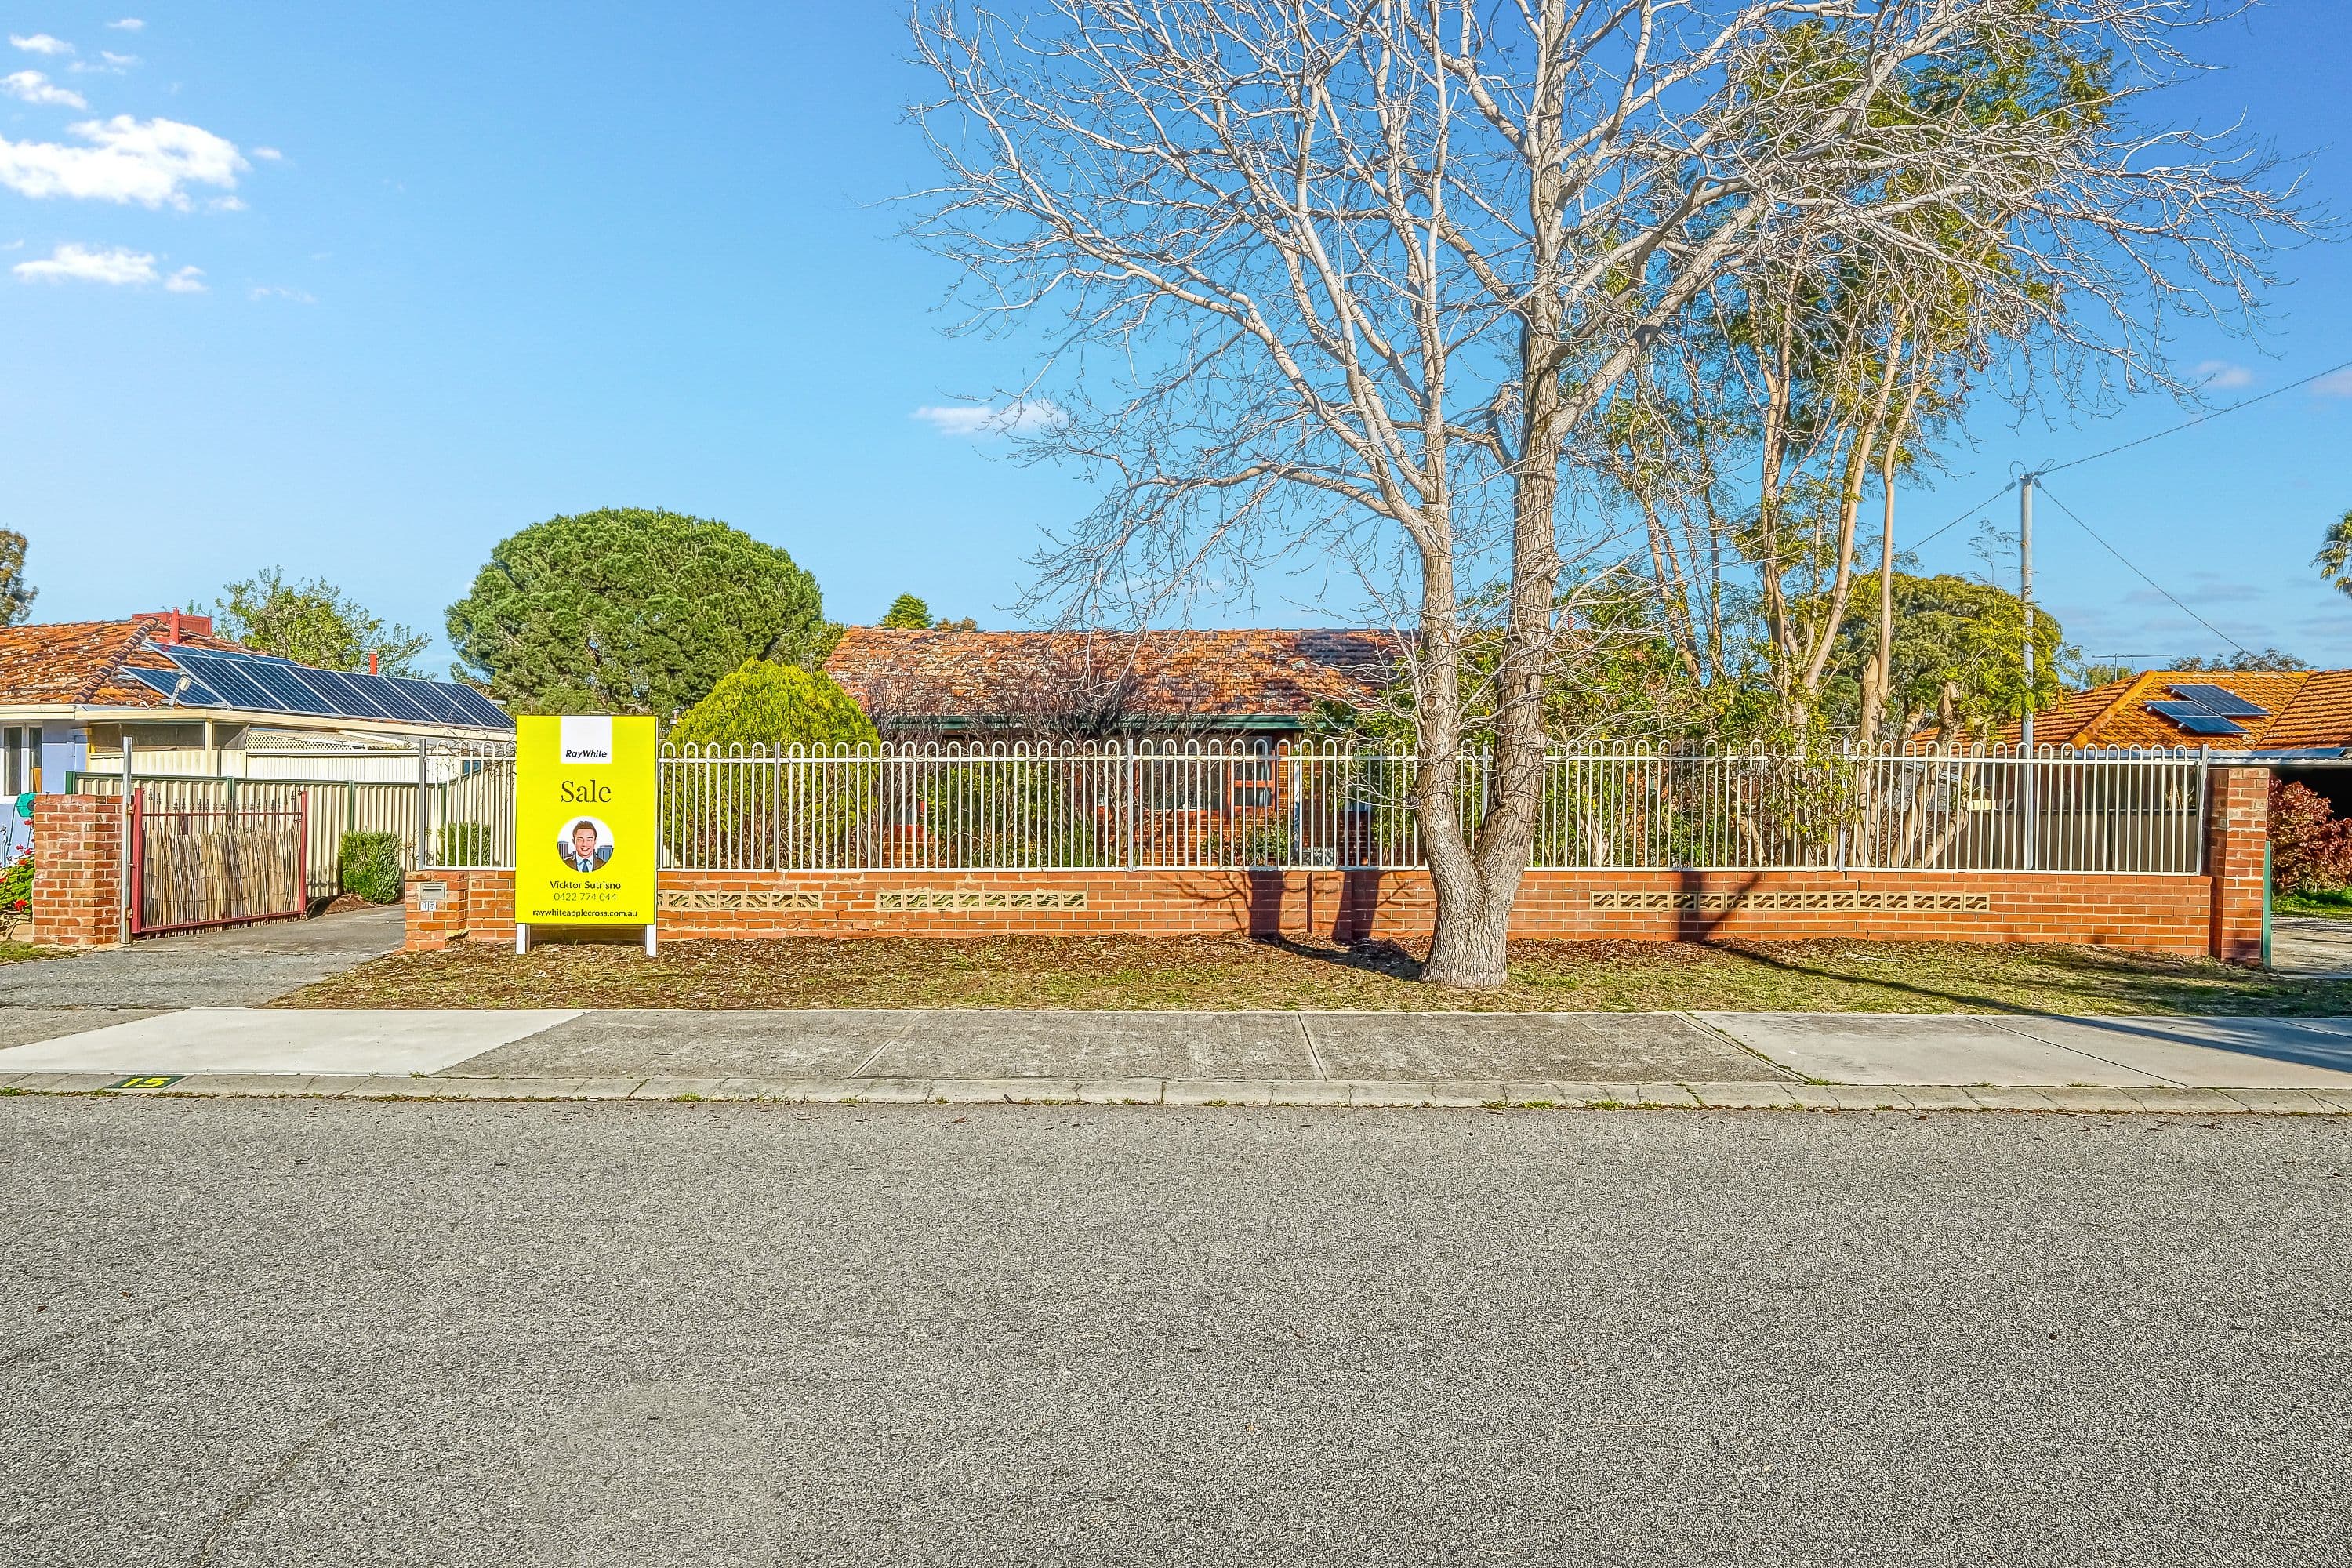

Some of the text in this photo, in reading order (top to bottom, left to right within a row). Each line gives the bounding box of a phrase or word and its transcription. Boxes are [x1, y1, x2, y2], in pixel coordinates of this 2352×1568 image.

[565, 750, 608, 759] RayWhite
[561, 779, 612, 803] Sale
[550, 880, 621, 890] Vicktor Sutrisno
[554, 892, 616, 902] 0422 774 044
[532, 909, 637, 918] raywhiteapplecross.com.au
[121, 1077, 171, 1088] 15
